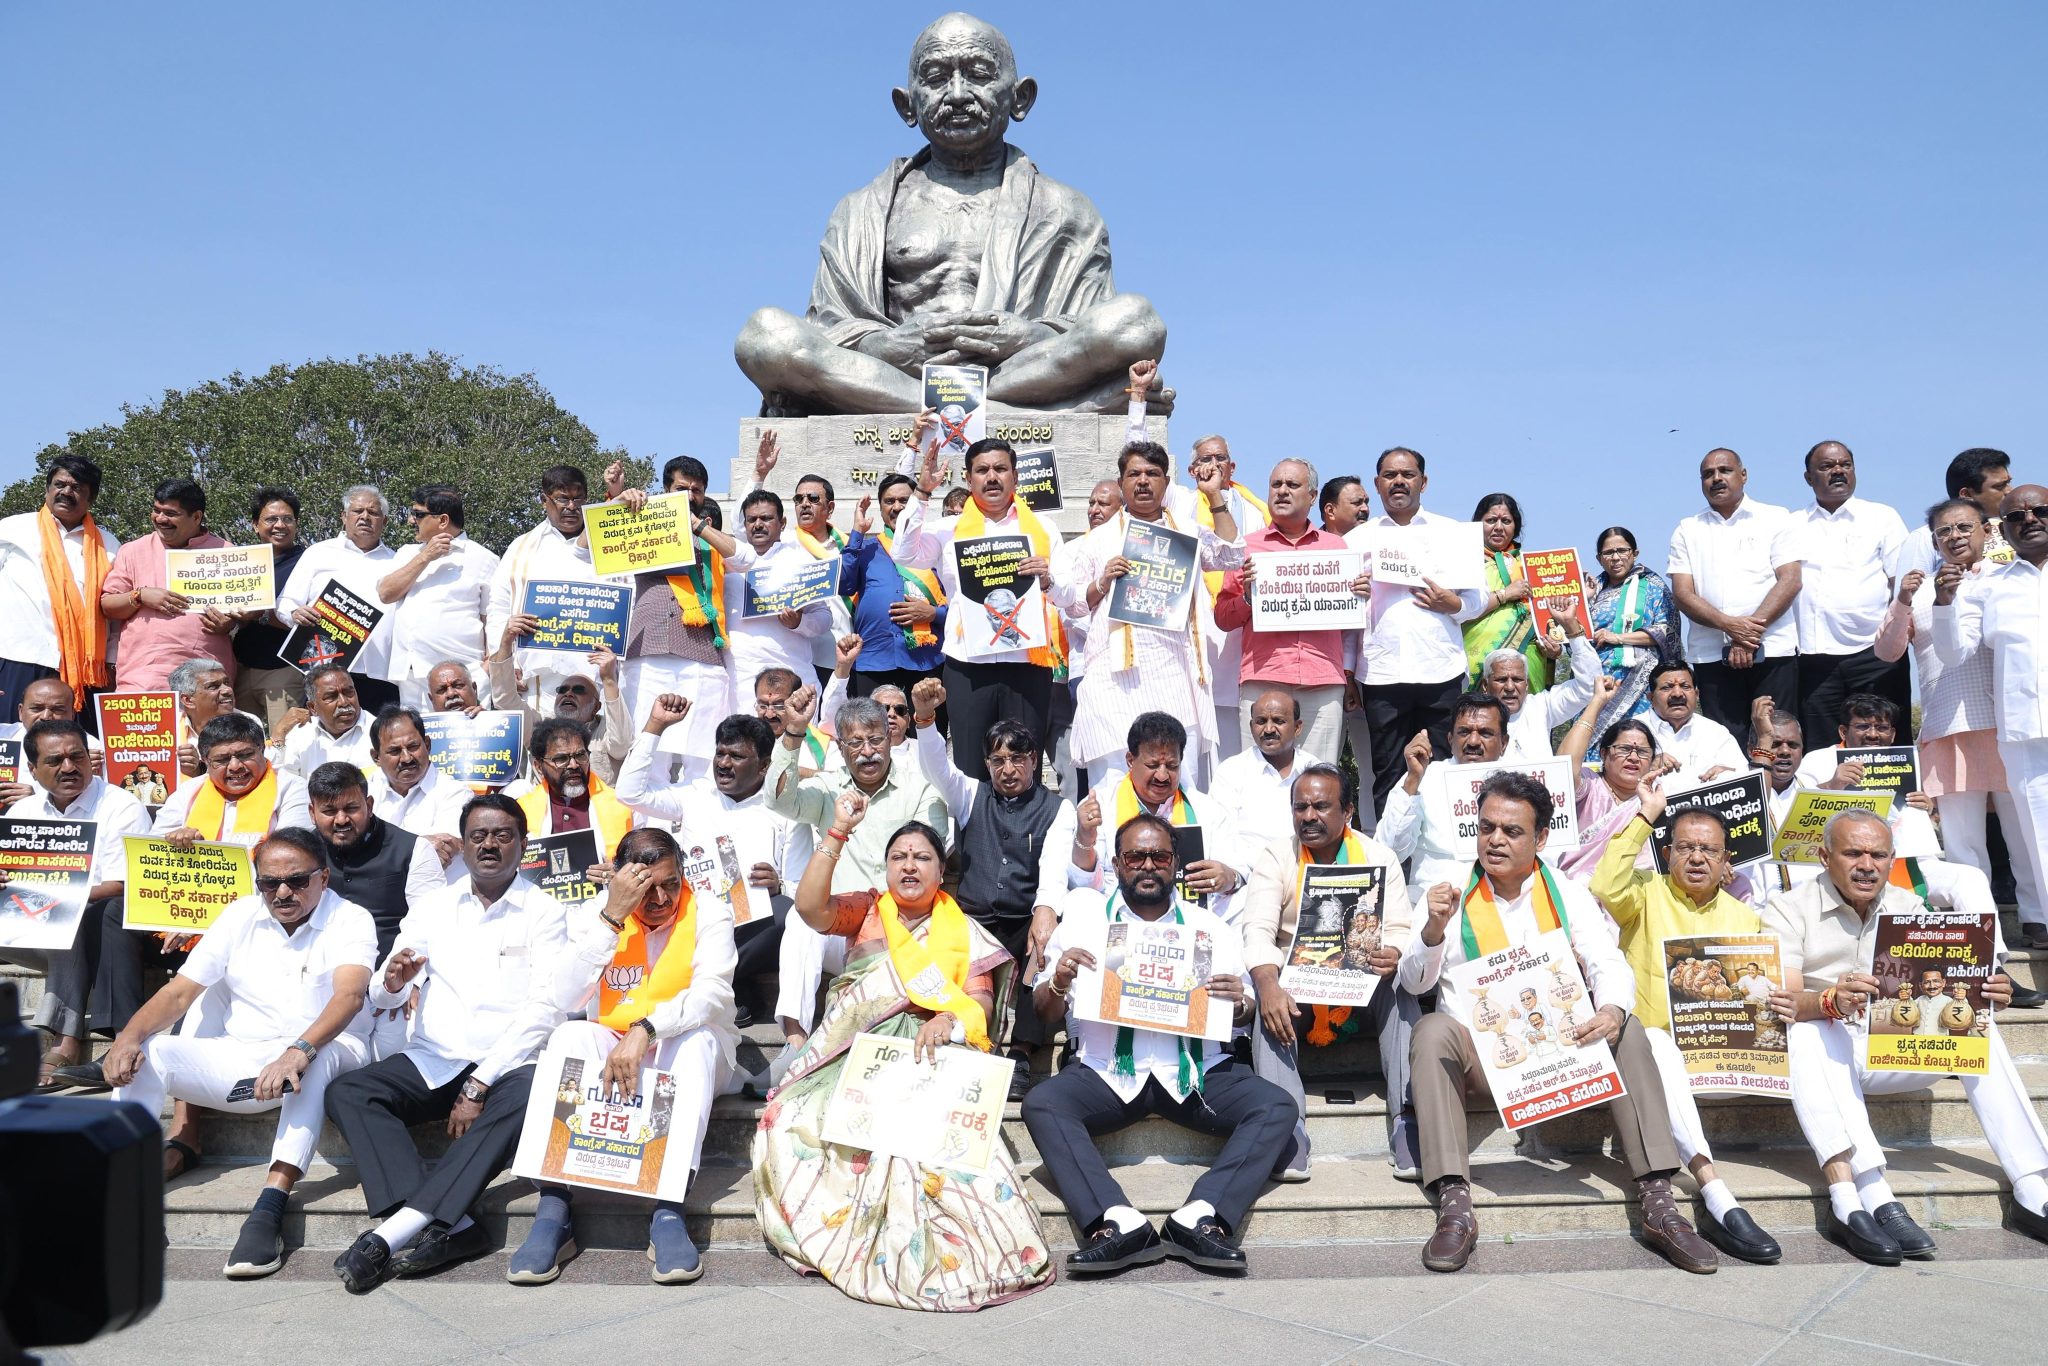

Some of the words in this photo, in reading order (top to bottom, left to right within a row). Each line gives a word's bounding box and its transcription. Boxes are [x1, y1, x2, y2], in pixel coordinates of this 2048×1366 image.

[602, 540, 639, 554] ಕಾಂಗ್ರೆಸ್
[1276, 562, 1310, 576] ಶಾಸಕರ
[1312, 560, 1340, 576] ಮನೆಗೆ
[1526, 556, 1546, 566] 2500
[178, 568, 220, 580] ಕಾಂಗ್ರೆಸ್
[224, 564, 266, 577] ನಾಯಕರ
[184, 581, 222, 590] ಗೂಂಡಾ
[534, 596, 556, 604] 2500
[1292, 599, 1310, 615] ಕ್ರಮ
[104, 698, 136, 710] 2500
[139, 696, 172, 709] ಕೋಟಿ
[120, 710, 161, 723] ನುಂಗಿದ
[108, 730, 174, 748] ರಾಜೀನಾಮೆ
[114, 748, 171, 762] ಯಾವಾಗ?
[1704, 787, 1746, 806] ಗೂಂಡಾ
[11, 824, 82, 840] ರಾಜ್ಯಪಾಲರಿಗೆ
[47, 839, 88, 851] ತೋರಿದ
[187, 858, 237, 872] ತೋರಿದವರ
[542, 872, 582, 886] ಸಂವಿಧಾನ
[139, 887, 184, 904] ಕಾಂಗ್ರೆಸ್
[1945, 932, 1965, 940] ಪಾಲು
[1890, 943, 1943, 958] ಆಡಿಯೋ
[1487, 954, 1506, 967] ಕಡು
[1477, 964, 1516, 986] ಕಾಂಗ್ರೆಸ್
[1518, 953, 1550, 972] ಸರ್ಕಾರ
[1946, 965, 1990, 978] ಬಹಿರಂಗ
[1126, 985, 1154, 998] ಕಾಂಗ್ರೆಸ್
[1156, 989, 1186, 1001] ಸರ್ಕಾರದ
[1674, 1012, 1712, 1022] ಅಬಕಾರಿ
[1918, 1040, 1957, 1050] ಸಚಿವರೇ
[1700, 1052, 1720, 1061] ಸಚಿವ
[1870, 1054, 1921, 1066] ರಾಜೀನಾಮೆ
[1924, 1054, 1953, 1072] ಕೊಟ್ಟು
[1954, 1056, 1985, 1069] ತೊಲಗಿ
[1741, 1076, 1790, 1090] ನೀಡಬೇಕು
[1512, 1092, 1570, 1121] ರಾಜೀನಾಮೆ
[589, 1112, 629, 1140] ಭ್ರಷ್ಟ
[574, 1136, 605, 1150] ಕಾಂಗ್ರೆಸ್
[606, 1142, 640, 1156] ಸರ್ಕಾರದ
